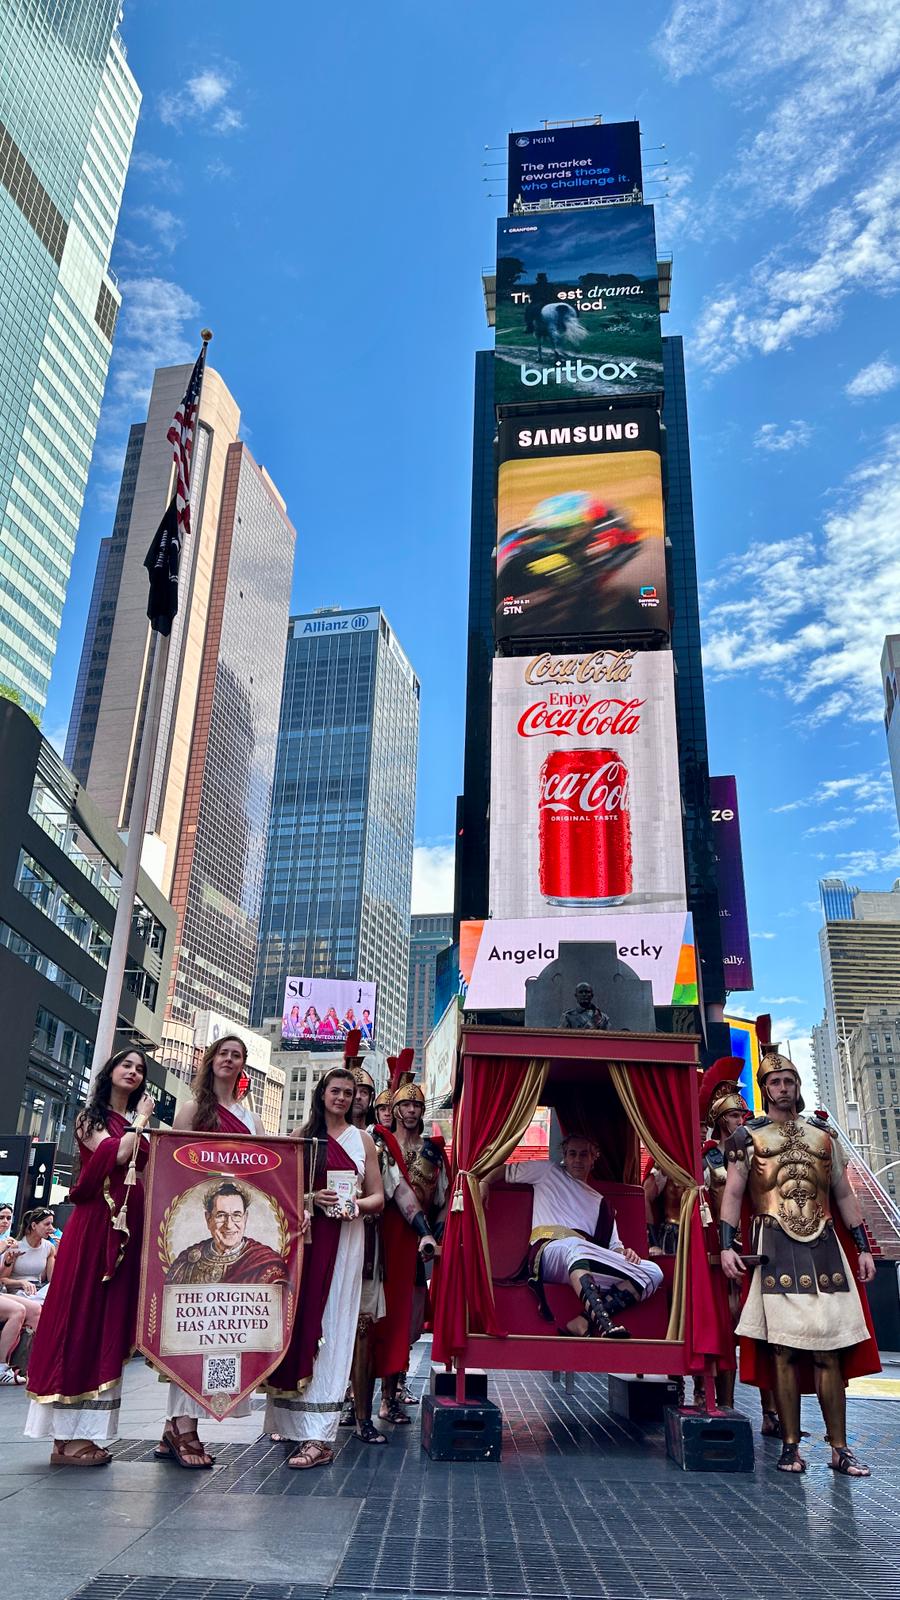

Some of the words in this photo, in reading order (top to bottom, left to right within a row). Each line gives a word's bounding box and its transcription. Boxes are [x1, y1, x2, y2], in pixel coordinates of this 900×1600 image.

[533, 136, 555, 145] PGIM
[521, 163, 545, 172] The
[547, 158, 593, 170] market
[521, 170, 572, 182] rewards
[575, 167, 611, 177] those
[521, 182, 548, 192] who
[551, 177, 615, 189] challenge
[618, 174, 631, 183] it.
[587, 285, 645, 299] drama.
[574, 299, 608, 313] iod.
[520, 359, 638, 387] britbox
[518, 422, 640, 447] SAMSUNG
[303, 620, 349, 634] Allianz
[524, 649, 639, 686] Coca-Cola
[549, 692, 592, 708] Enjoy
[517, 698, 648, 738] Coca-Cola
[488, 943, 556, 965] Angela
[618, 939, 664, 961] ecky
[287, 980, 313, 997] SU
[201, 1150, 215, 1162] DI
[217, 1152, 269, 1165] MARCO
[175, 1292, 204, 1304] THE
[205, 1291, 272, 1303] ORIGINAL
[176, 1305, 229, 1318] ROMAN
[231, 1304, 270, 1316] PINSA
[177, 1320, 204, 1332] HAS
[207, 1319, 269, 1330] ARRIVED
[198, 1333, 215, 1345] IN
[217, 1332, 248, 1344] NYC
